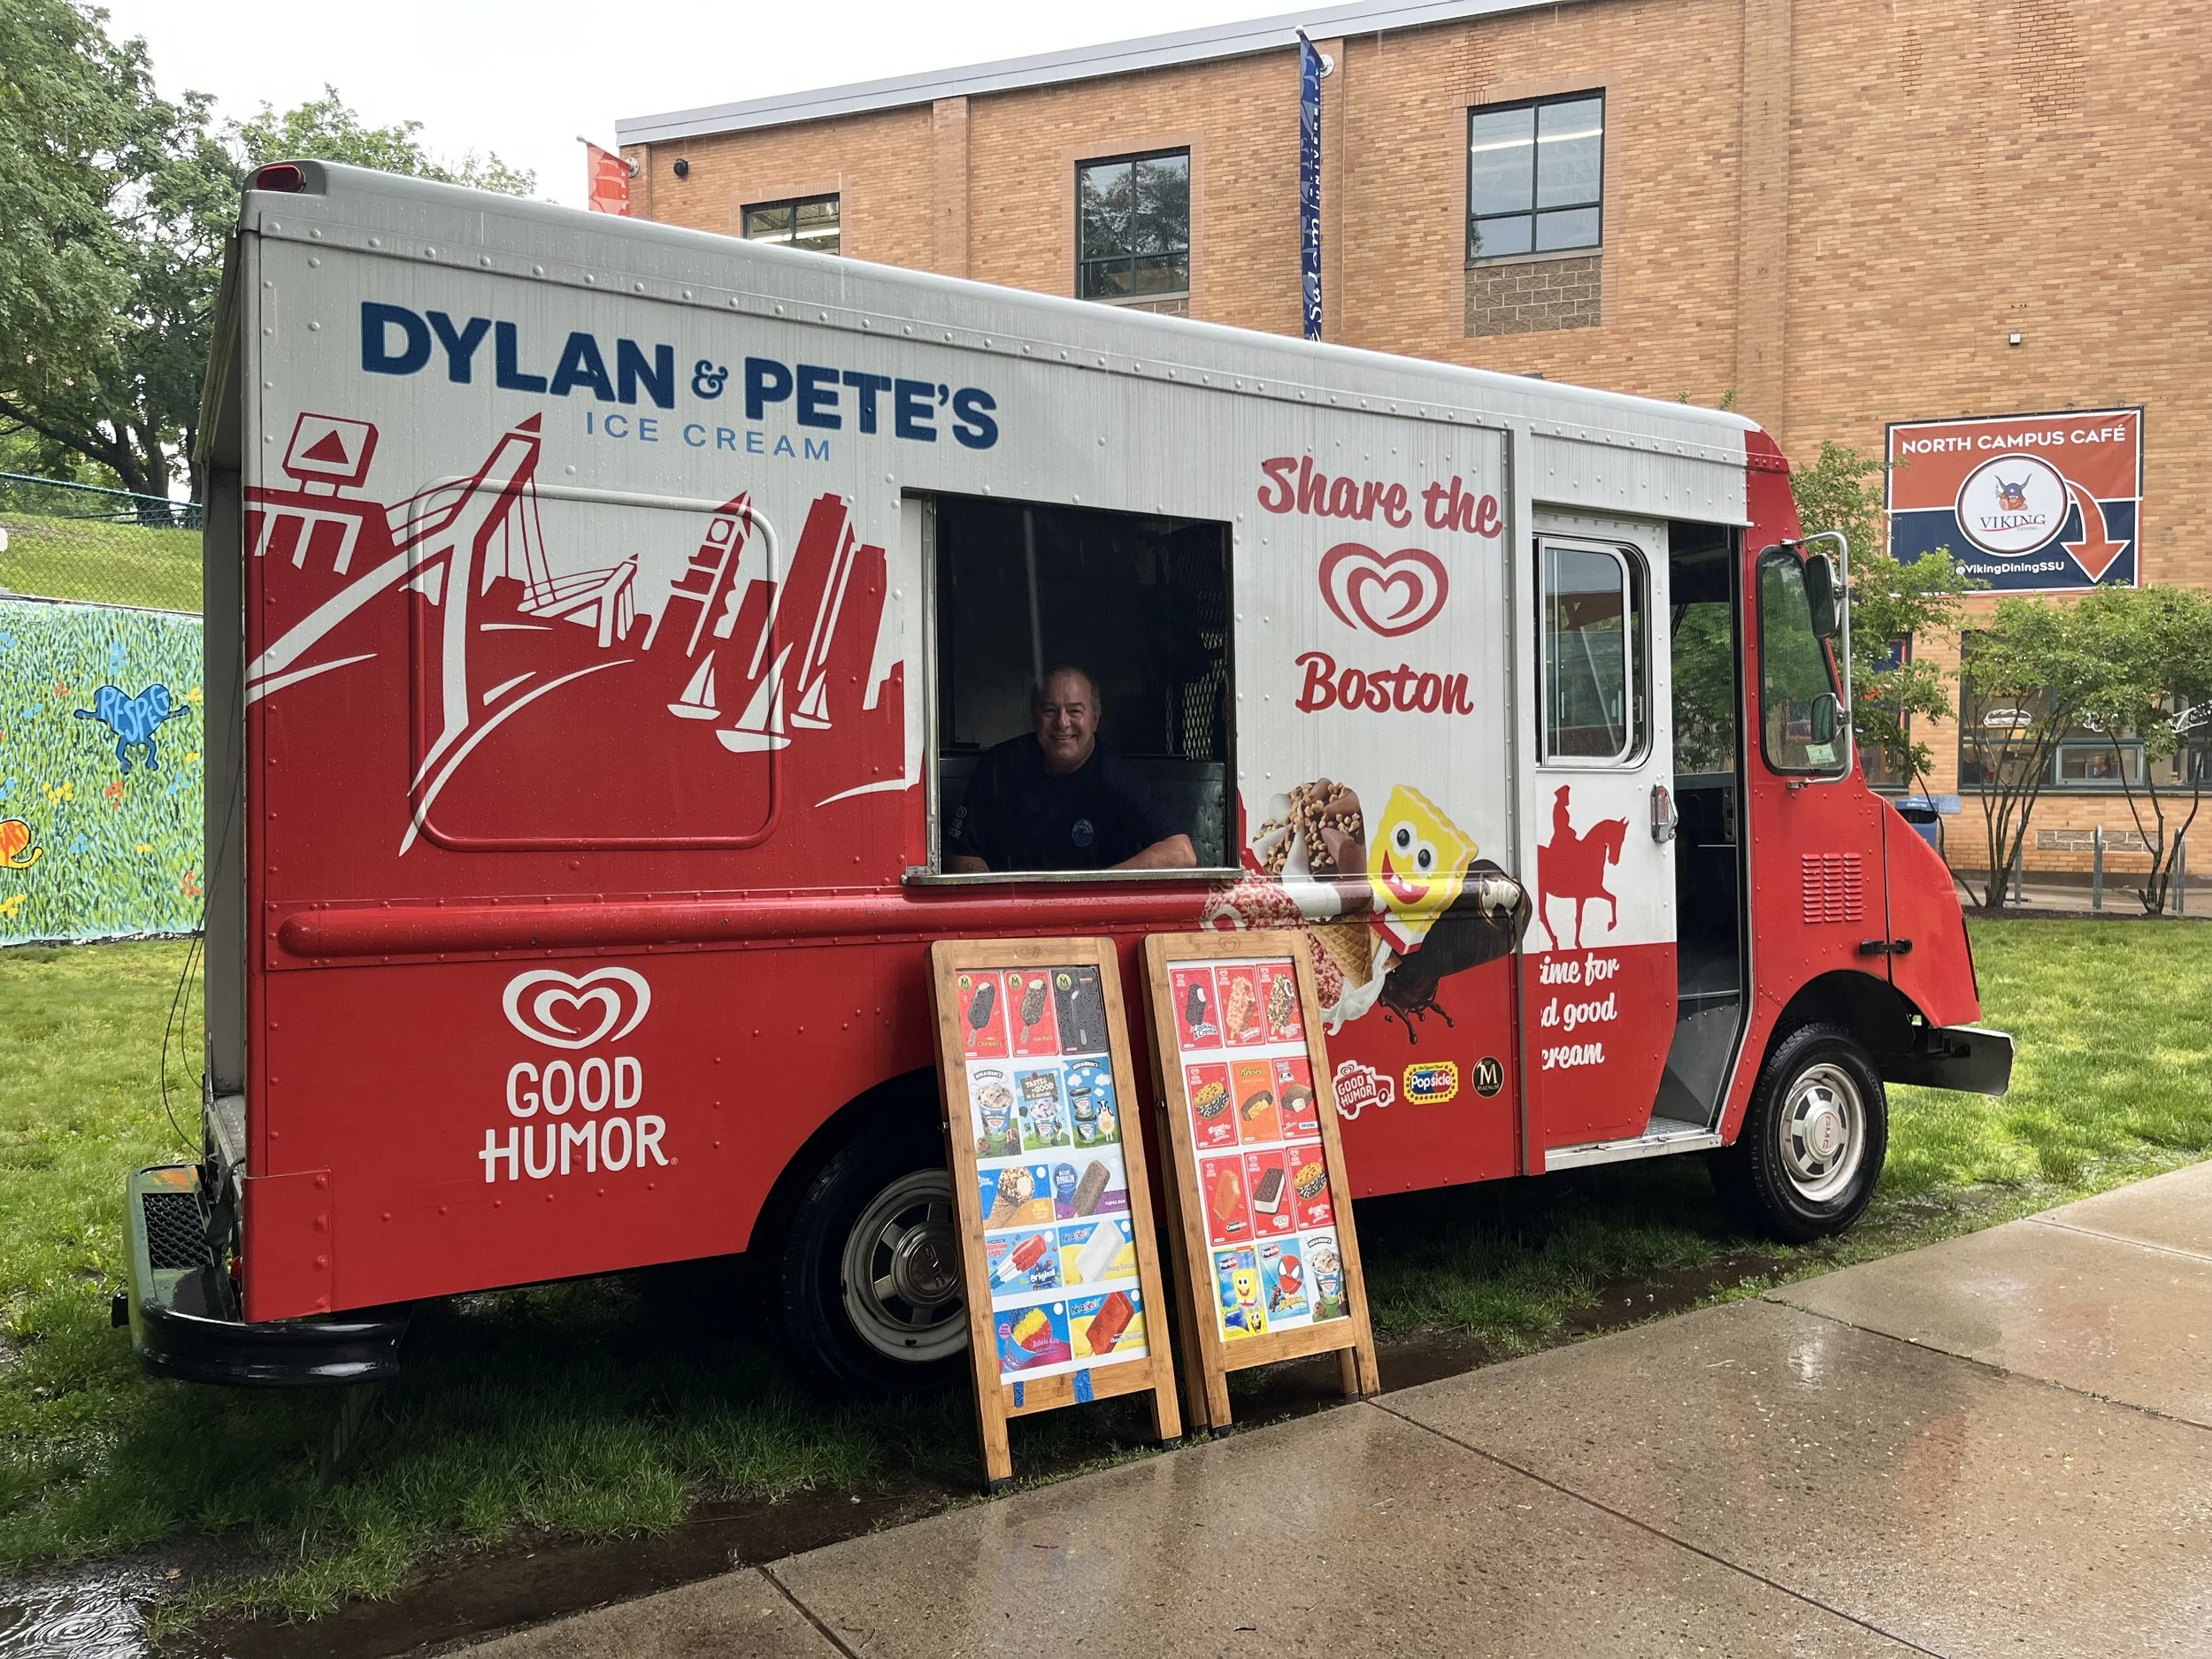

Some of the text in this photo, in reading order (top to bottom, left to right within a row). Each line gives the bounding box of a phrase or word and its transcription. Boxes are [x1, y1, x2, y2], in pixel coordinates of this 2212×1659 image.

[361, 301, 1000, 450] DYLAN & PETE'S
[587, 411, 830, 462] ICE CREAM
[1901, 424, 2126, 455] NORTH CAMPUS CAFÉ
[1257, 456, 1502, 538] Share the
[1978, 513, 2047, 529] VIKING
[1955, 561, 2065, 575] @VikingDiningSSU
[1294, 651, 1474, 715] Boston
[100, 686, 170, 743] RESPECT
[1540, 952, 1620, 987] ime for
[1563, 992, 1618, 1032] good
[506, 1056, 642, 1118] GOOD
[1034, 1081, 1054, 1093] GOOD
[1338, 1075, 1364, 1095] GOOD
[1340, 1085, 1372, 1107] HUMOR
[1410, 1072, 1451, 1090] Popsicle
[479, 1115, 669, 1183] HUMOR
[1030, 1268, 1056, 1283] Original
[1033, 1337, 1048, 1348] Bubble
